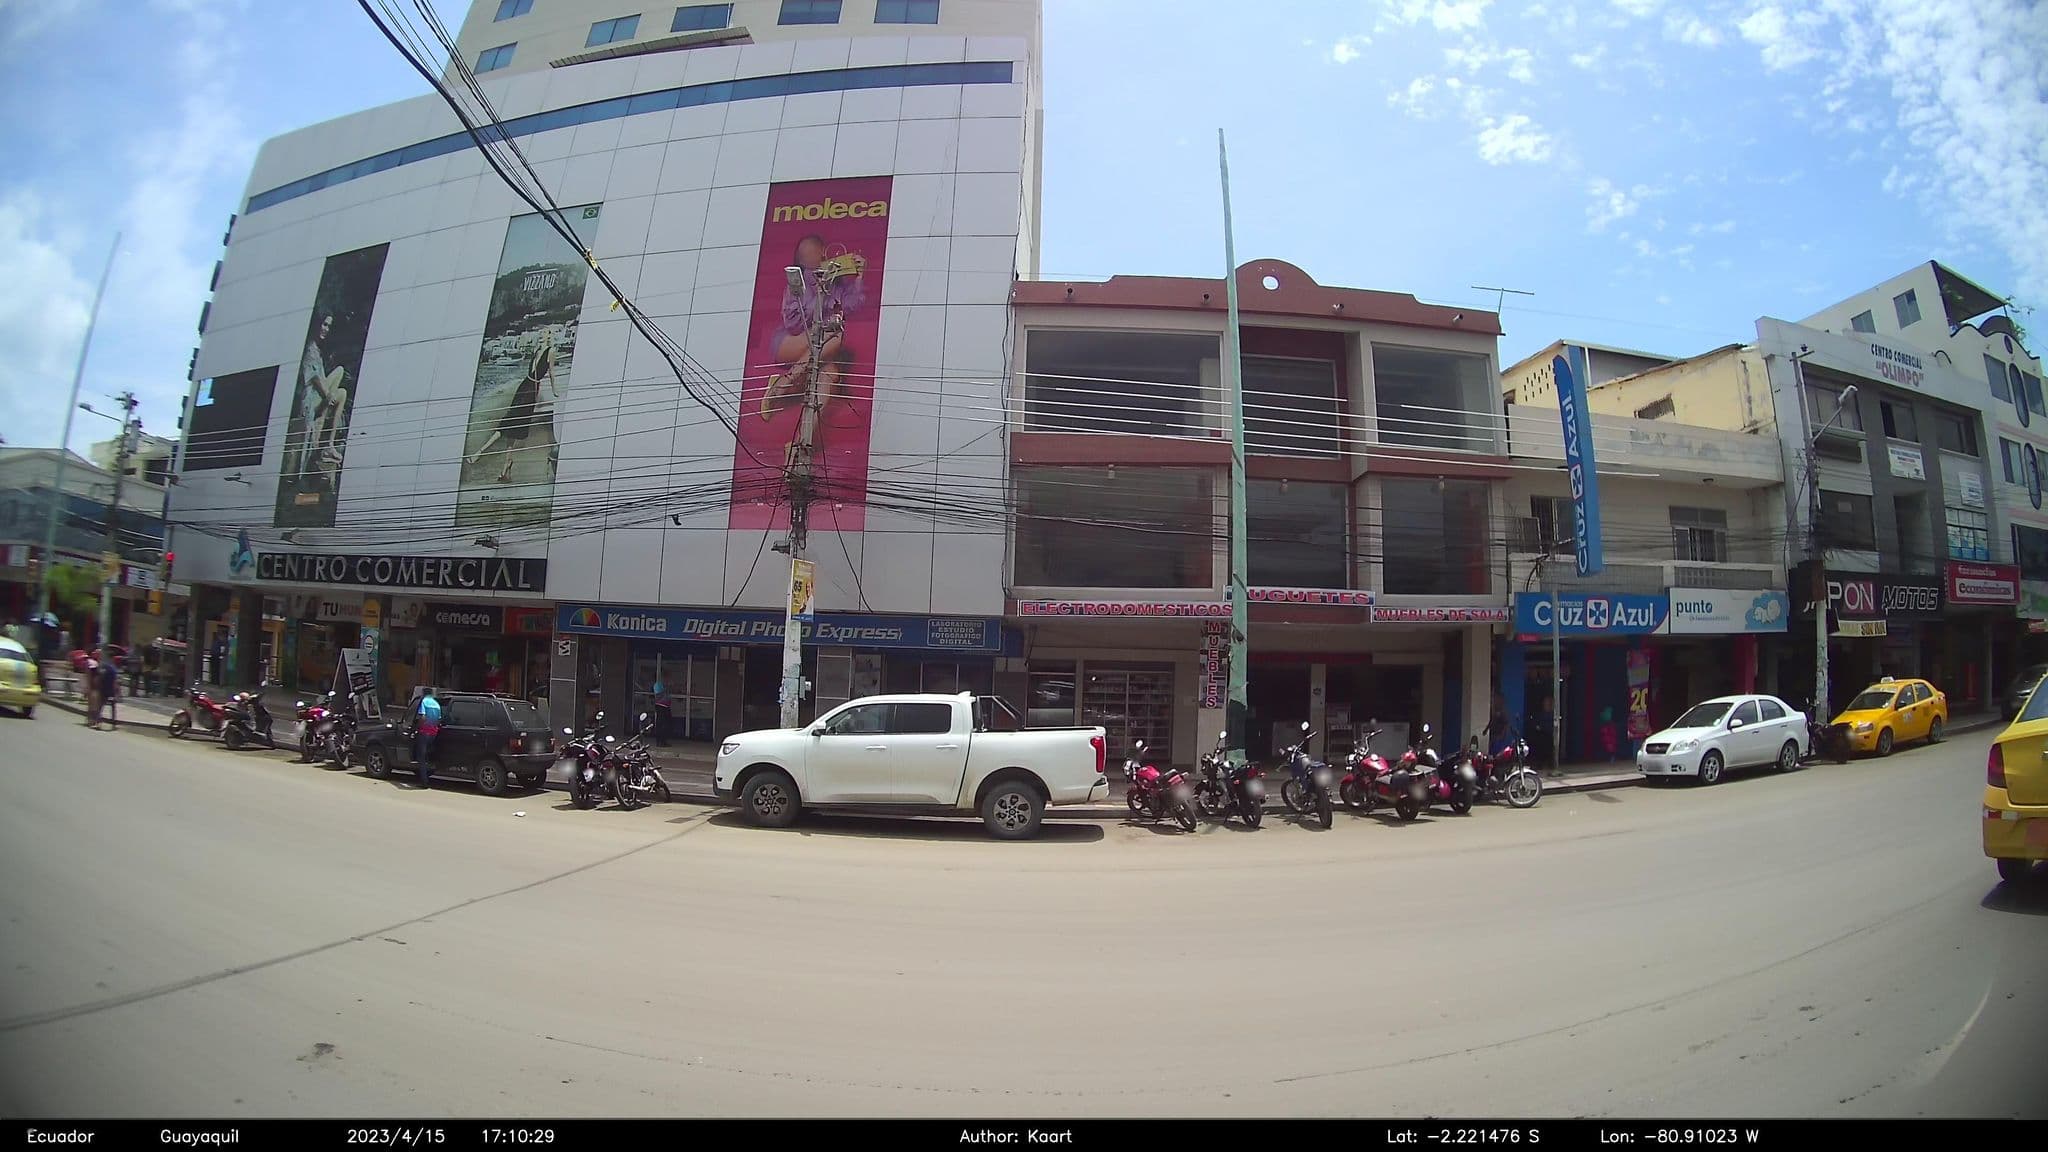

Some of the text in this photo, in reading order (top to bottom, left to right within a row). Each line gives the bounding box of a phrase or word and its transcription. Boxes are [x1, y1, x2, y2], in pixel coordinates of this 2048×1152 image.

[772, 197, 888, 222] moleca
[523, 273, 558, 291] VIZZANO
[1871, 343, 1923, 370] CENTRO COMERCIAL
[1576, 502, 1589, 575] Cruz
[260, 553, 531, 589] CENTRO COMERCIAL
[1022, 602, 1233, 616] ELECTRODOMESTICOS
[1248, 588, 1371, 605] UGUETES
[1676, 599, 1713, 617] punto
[1803, 580, 1939, 613] JPON MOTOS
[1375, 608, 1506, 621] MUEBLES DE SALA
[1534, 601, 1654, 627] Cuz Azul
[607, 612, 900, 643] Konica Digital Phoo Express
[1205, 621, 1222, 709] MUEBLES
